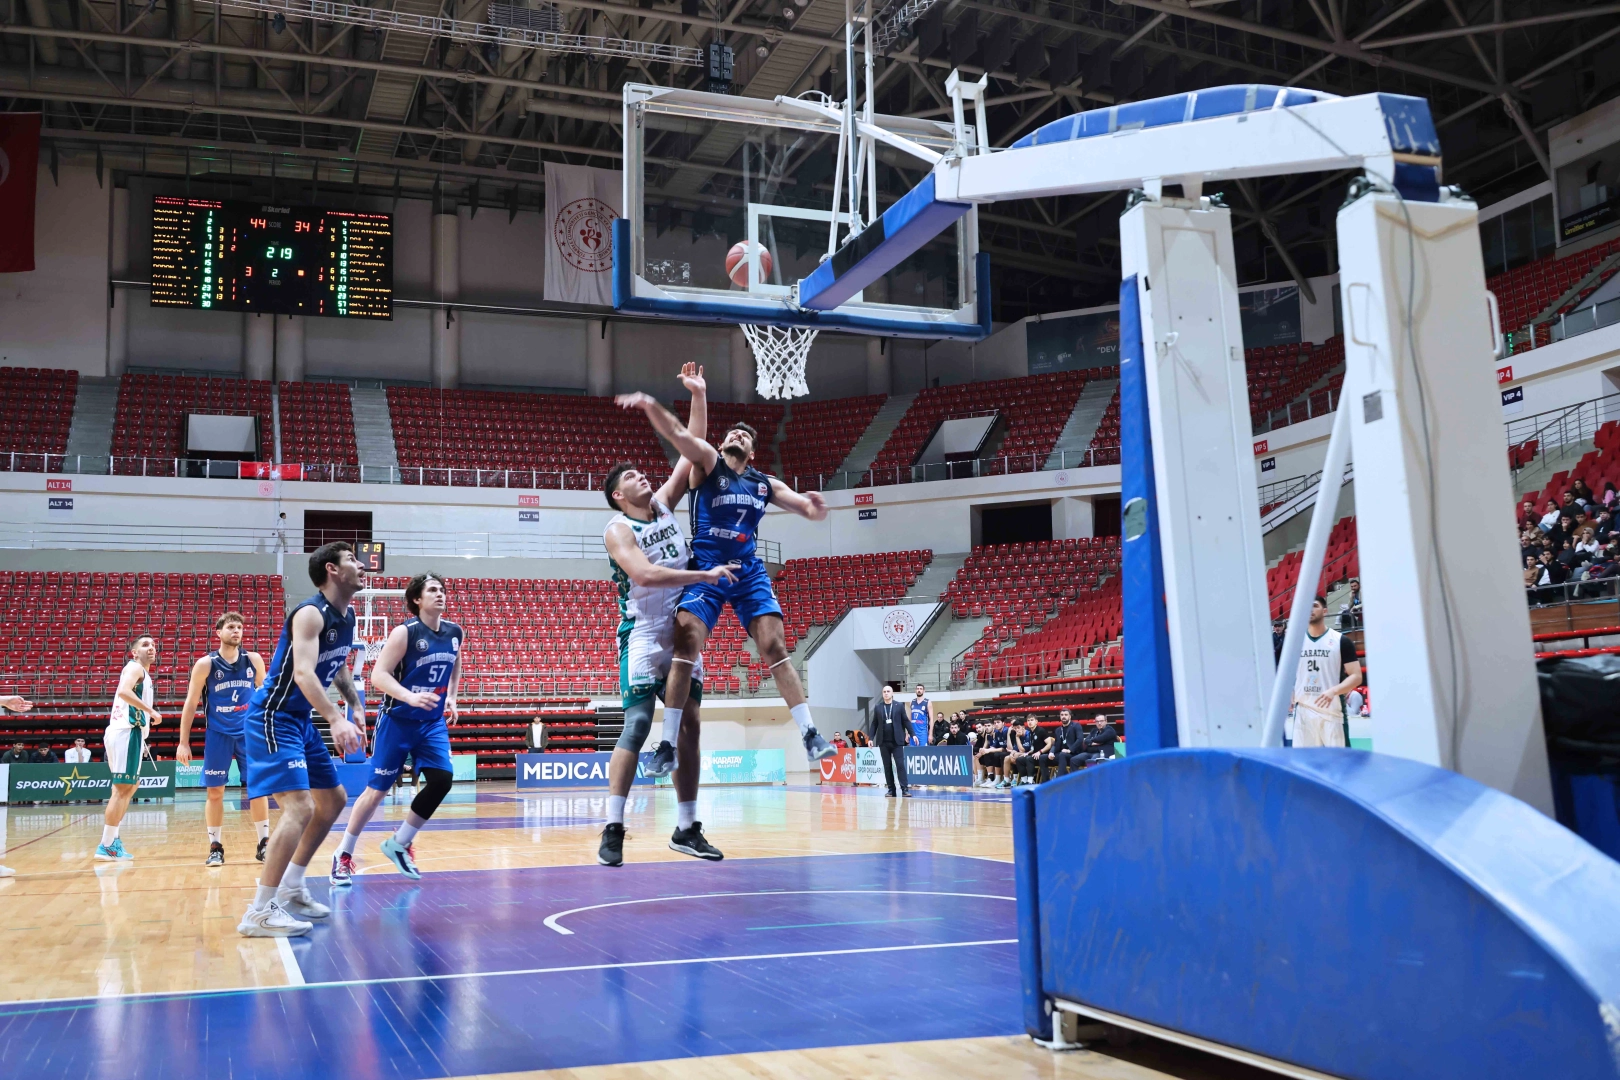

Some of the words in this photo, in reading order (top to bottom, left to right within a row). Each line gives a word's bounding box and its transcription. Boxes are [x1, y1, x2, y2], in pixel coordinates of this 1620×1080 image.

[250, 218, 266, 229] 44
[295, 221, 310, 232] 34
[245, 266, 252, 276] 3
[272, 269, 278, 277] 2
[1503, 392, 1514, 401] VIP
[735, 509, 747, 527] 7
[363, 544, 369, 552] 2
[373, 544, 381, 552] 19
[660, 544, 678, 559] 18
[370, 555, 378, 569] 5
[1307, 660, 1320, 672] 24
[428, 665, 447, 682] 57
[232, 690, 239, 702] 4
[713, 756, 743, 764] KARATAY
[907, 756, 961, 775] MEDICANA
[16, 781, 65, 789] SPORUN
[71, 779, 111, 788] YILDIZI
